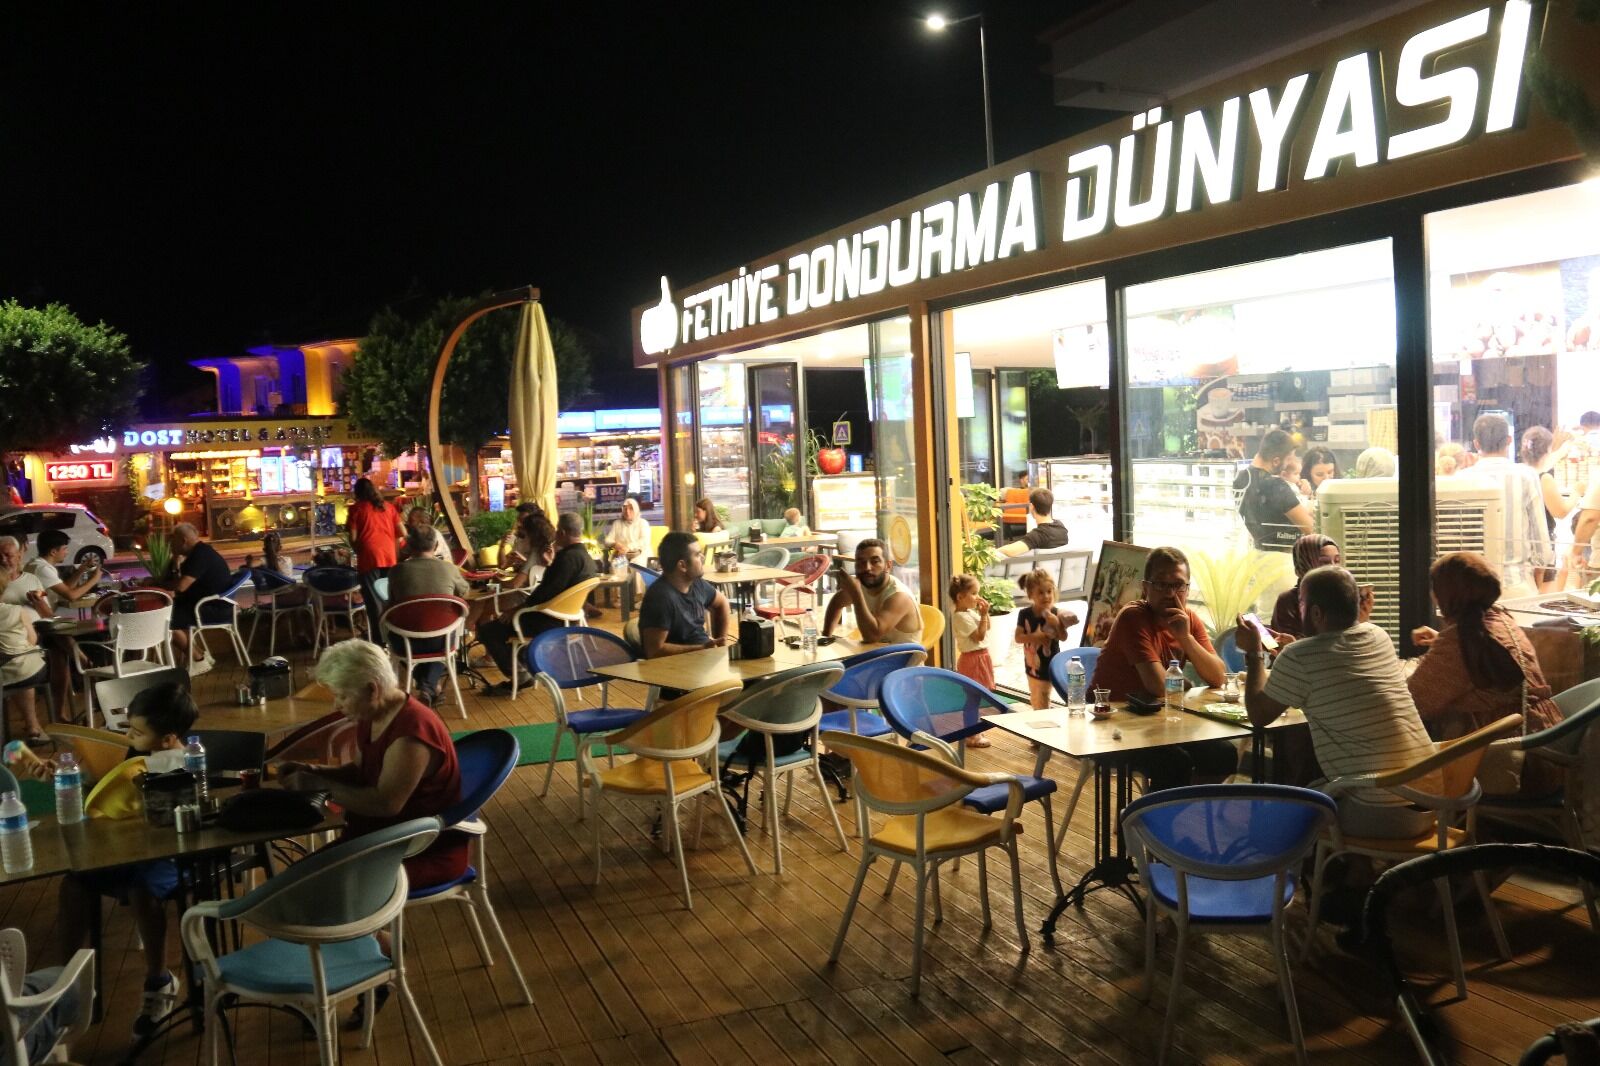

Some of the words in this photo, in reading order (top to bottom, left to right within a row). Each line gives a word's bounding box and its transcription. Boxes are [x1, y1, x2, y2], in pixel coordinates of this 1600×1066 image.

[682, 264, 780, 344] FETHİYE
[786, 171, 1038, 315] DONDURMA
[1062, 0, 1532, 242] DÜNYASI
[124, 429, 183, 446] DOST
[185, 427, 251, 444] HOTEL
[49, 464, 88, 480] 1250
[91, 463, 111, 478] TL
[601, 486, 623, 496] BUZ
